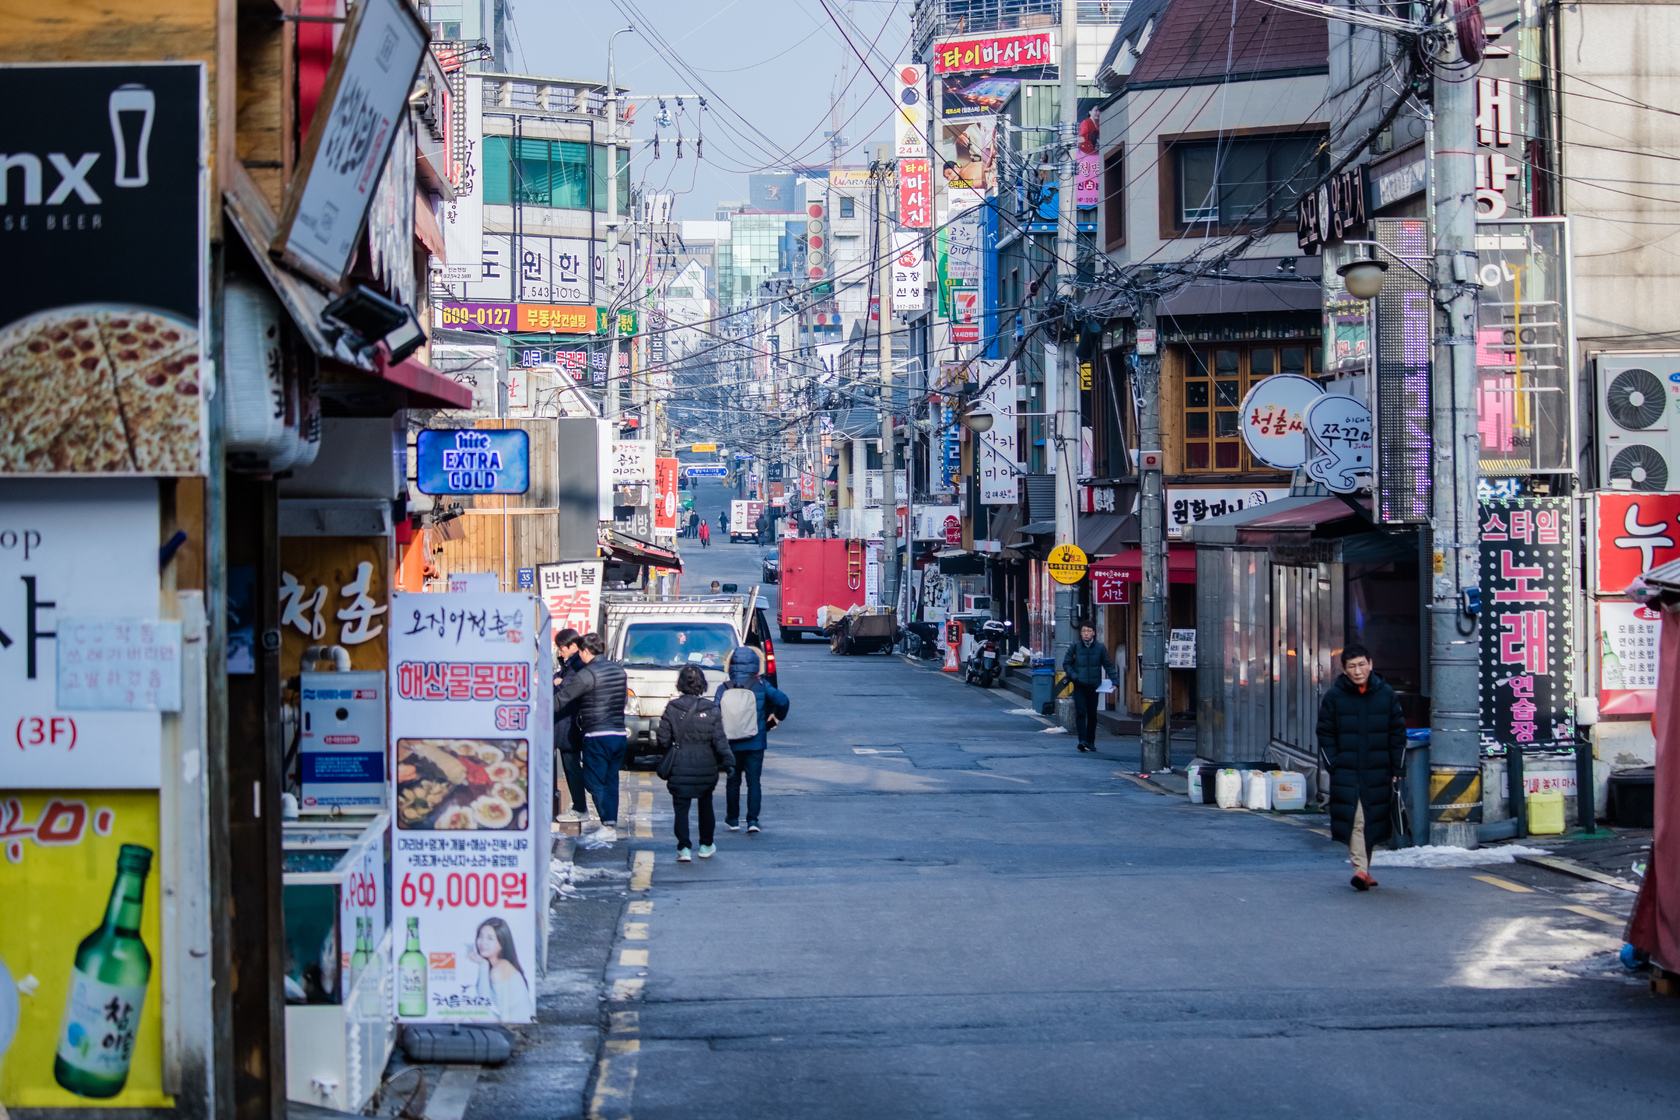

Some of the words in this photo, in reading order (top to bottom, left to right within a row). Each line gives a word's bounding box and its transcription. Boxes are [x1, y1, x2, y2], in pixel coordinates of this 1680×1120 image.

[905, 163, 927, 173] 타이
[907, 174, 926, 223] 마사지
[47, 214, 102, 230] BEER
[443, 450, 503, 470] EXTRA
[449, 471, 497, 490] COLD
[1482, 510, 1560, 545] 스타일
[280, 561, 388, 645] 청춘
[1102, 589, 1123, 600] 시간
[1495, 549, 1549, 675] 노래
[403, 606, 508, 645] 오징어청춘
[398, 662, 530, 700] 해산물몽땅!
[495, 704, 530, 730] SET
[1508, 674, 1538, 743] 연습장
[15, 716, 78, 753] (3F)
[400, 872, 527, 911] 69,000원
